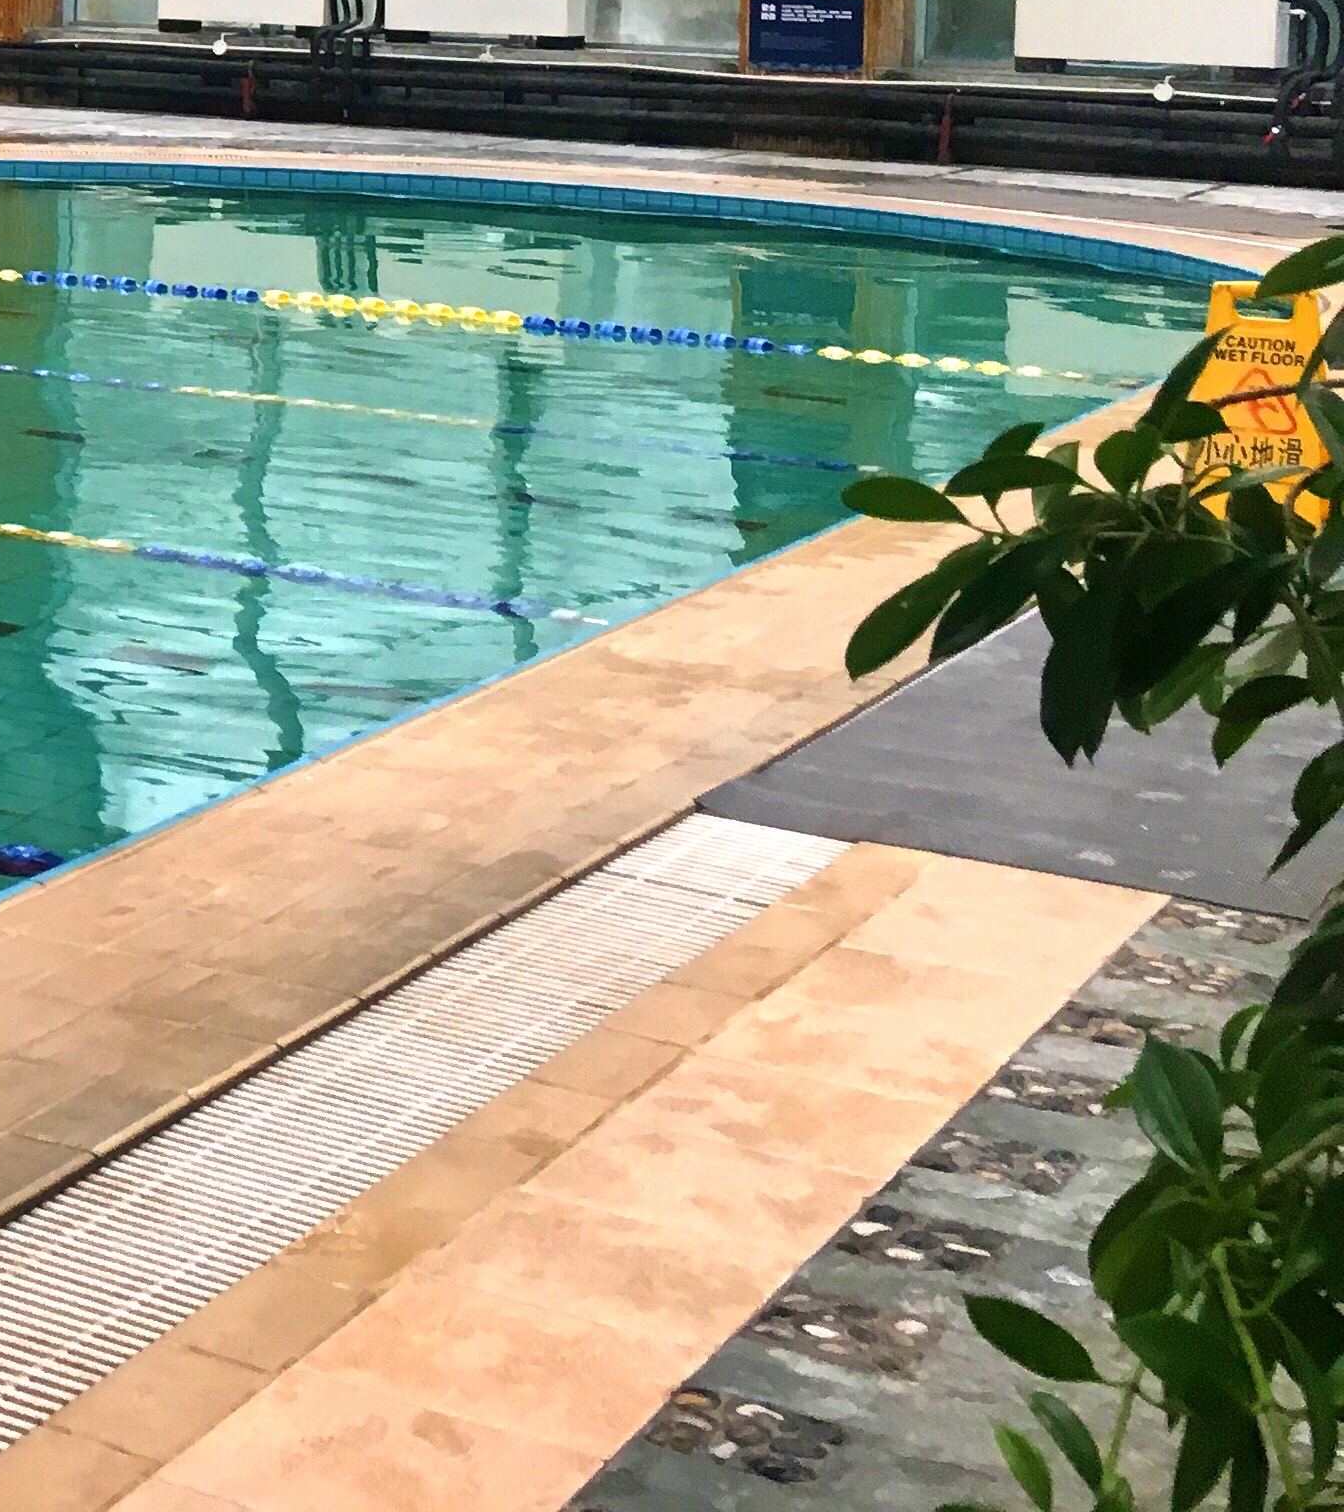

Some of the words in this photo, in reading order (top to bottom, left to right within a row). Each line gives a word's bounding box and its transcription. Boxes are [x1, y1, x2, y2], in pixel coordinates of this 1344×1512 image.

[1225, 335, 1296, 352] CAUTION
[1214, 349, 1248, 362] WET
[1251, 351, 1305, 367] FLOOR
[1201, 434, 1304, 468] 小心地滑
